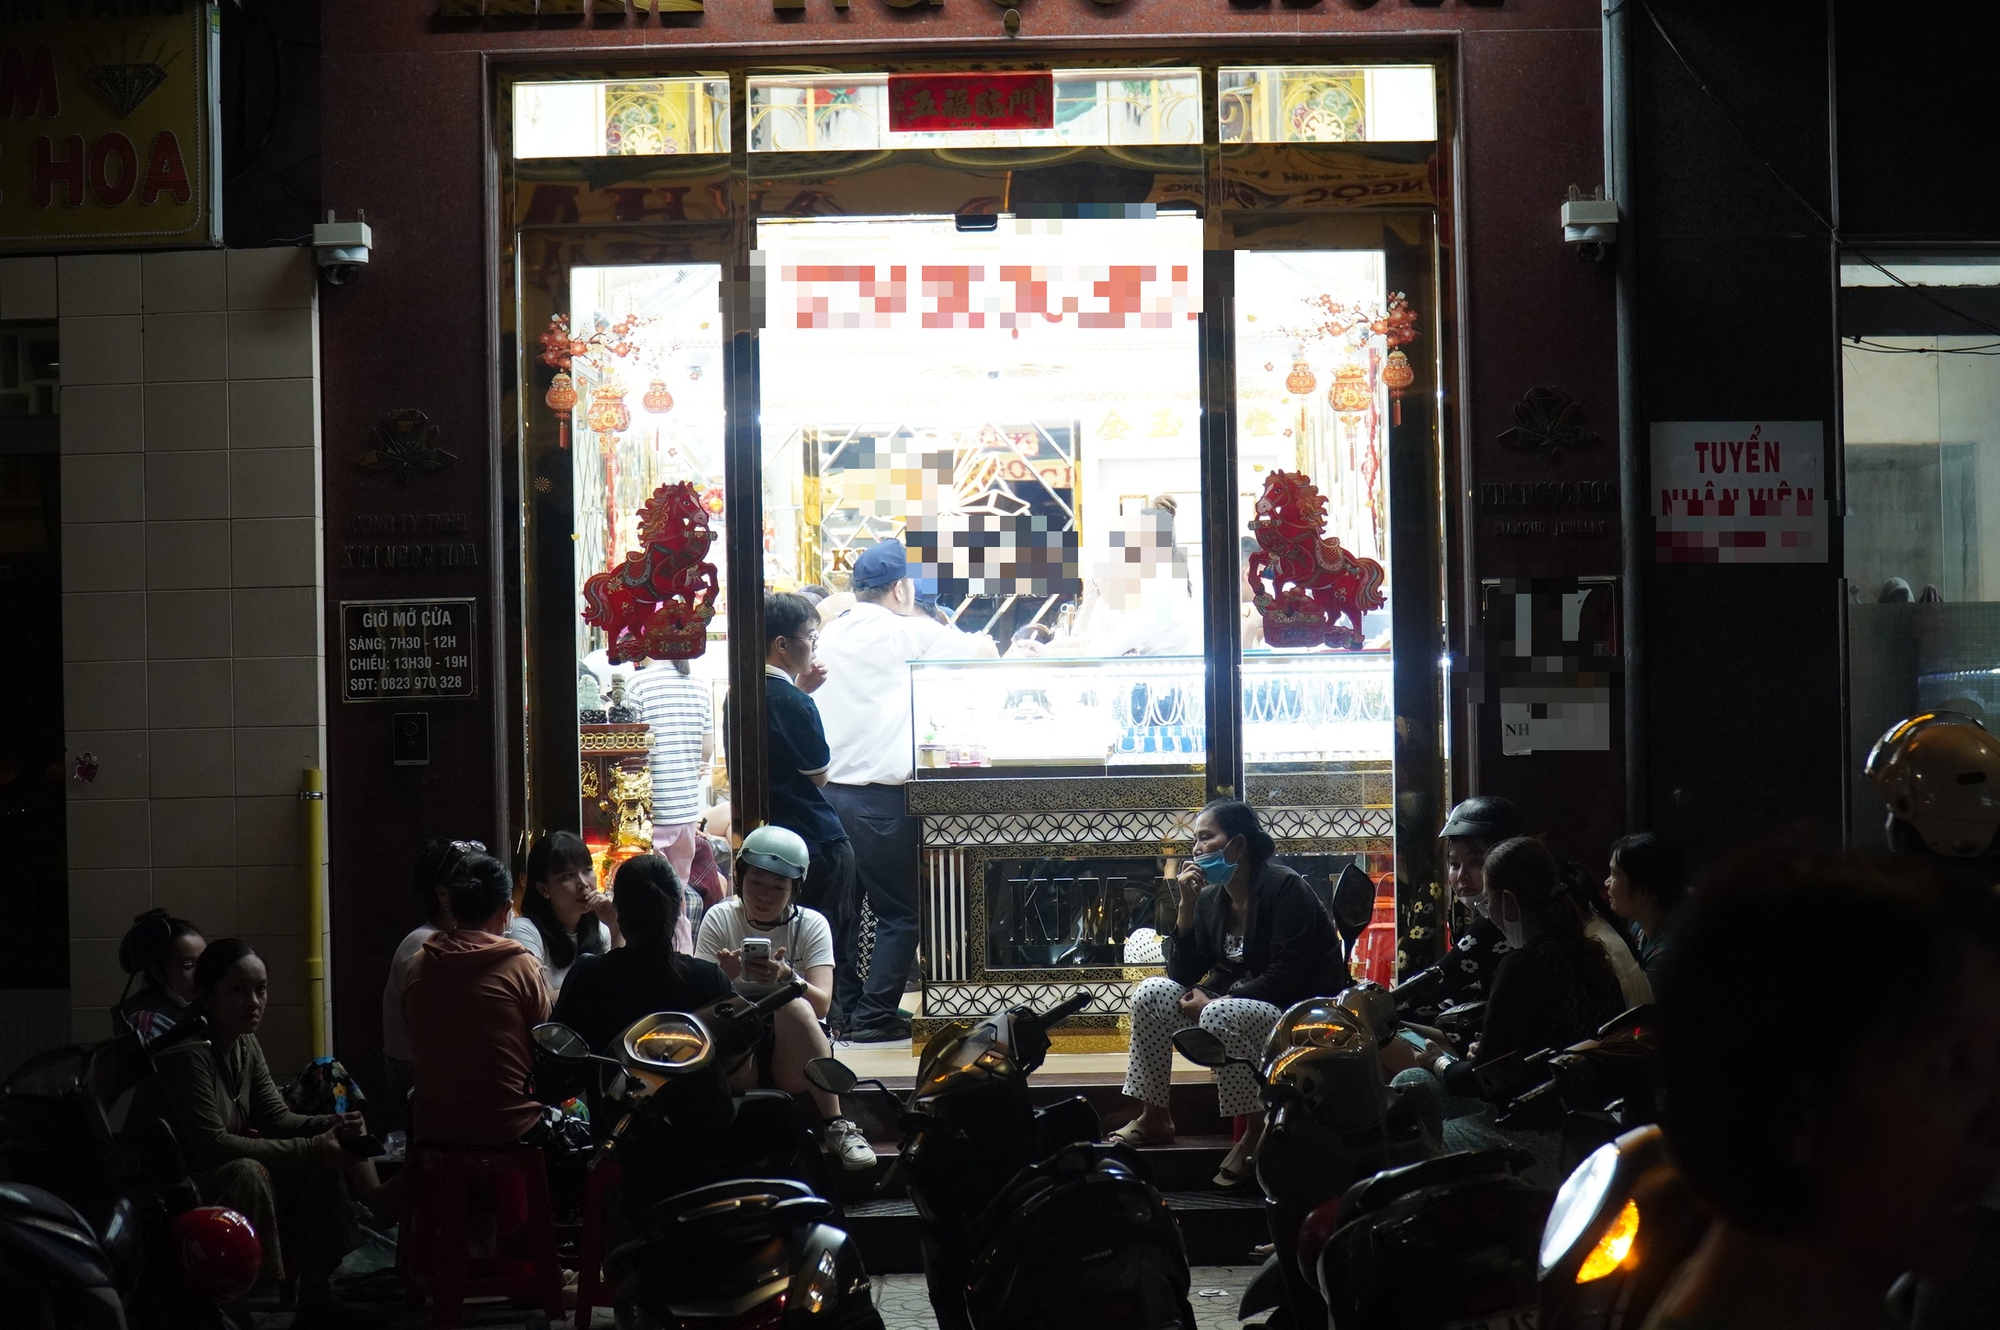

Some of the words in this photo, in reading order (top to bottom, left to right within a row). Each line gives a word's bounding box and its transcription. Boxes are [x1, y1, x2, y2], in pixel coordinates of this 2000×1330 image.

[35, 129, 193, 208] HOA
[1694, 424, 1780, 474] TUYỂN
[362, 608, 388, 628] GIỜ
[393, 607, 417, 627] MỞ
[422, 606, 452, 626] CỬA
[349, 635, 386, 651] SÁNG:
[390, 637, 421, 649] 7H30
[433, 636, 456, 648] 12H
[349, 653, 390, 671] CHIỀU:
[394, 656, 432, 669] 13H30
[444, 655, 467, 668] 19H
[350, 678, 378, 691] SĐT:
[381, 677, 411, 690] 0823
[414, 676, 437, 689] 970
[440, 675, 462, 688] 328
